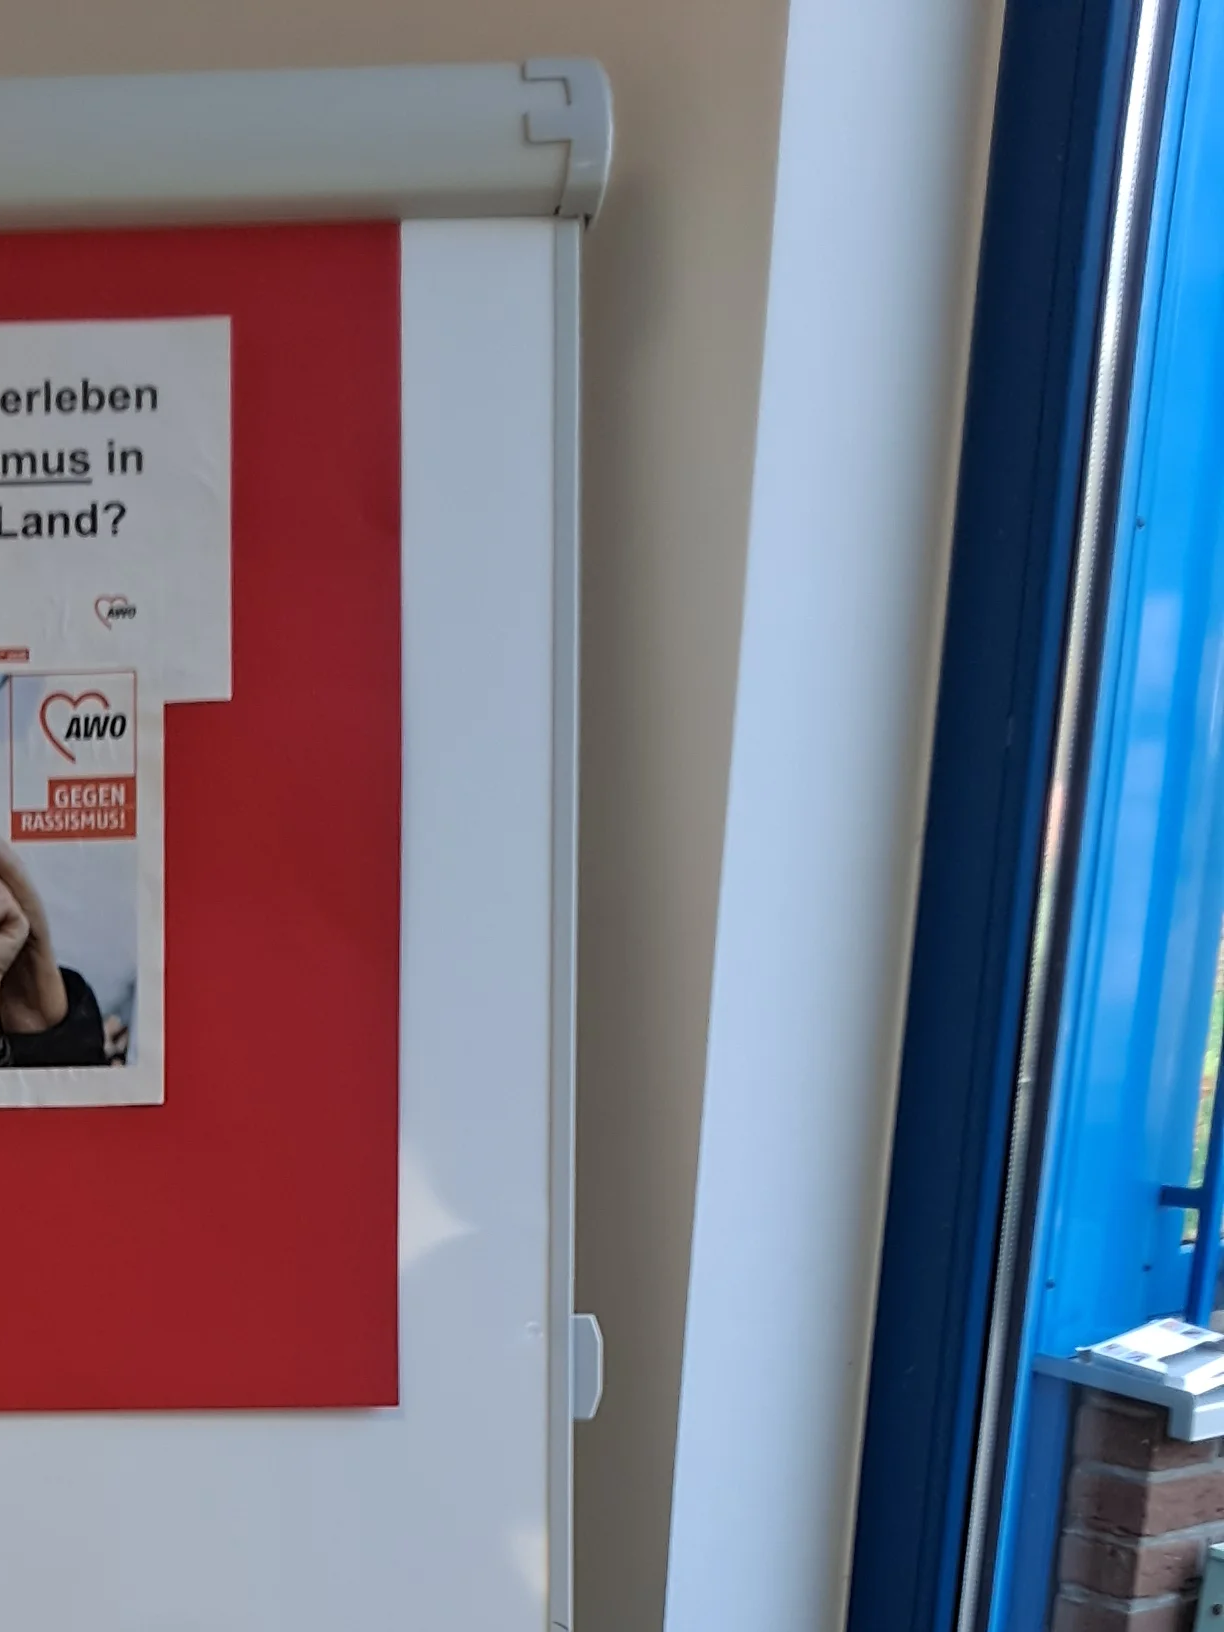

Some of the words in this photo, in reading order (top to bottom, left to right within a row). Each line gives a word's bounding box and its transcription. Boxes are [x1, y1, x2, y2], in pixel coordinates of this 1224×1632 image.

[0, 379, 158, 415] erleben
[106, 440, 144, 476] in
[64, 714, 126, 742] AWO
[54, 783, 125, 808] GEGEN
[21, 812, 125, 832] RASSISMUS!
